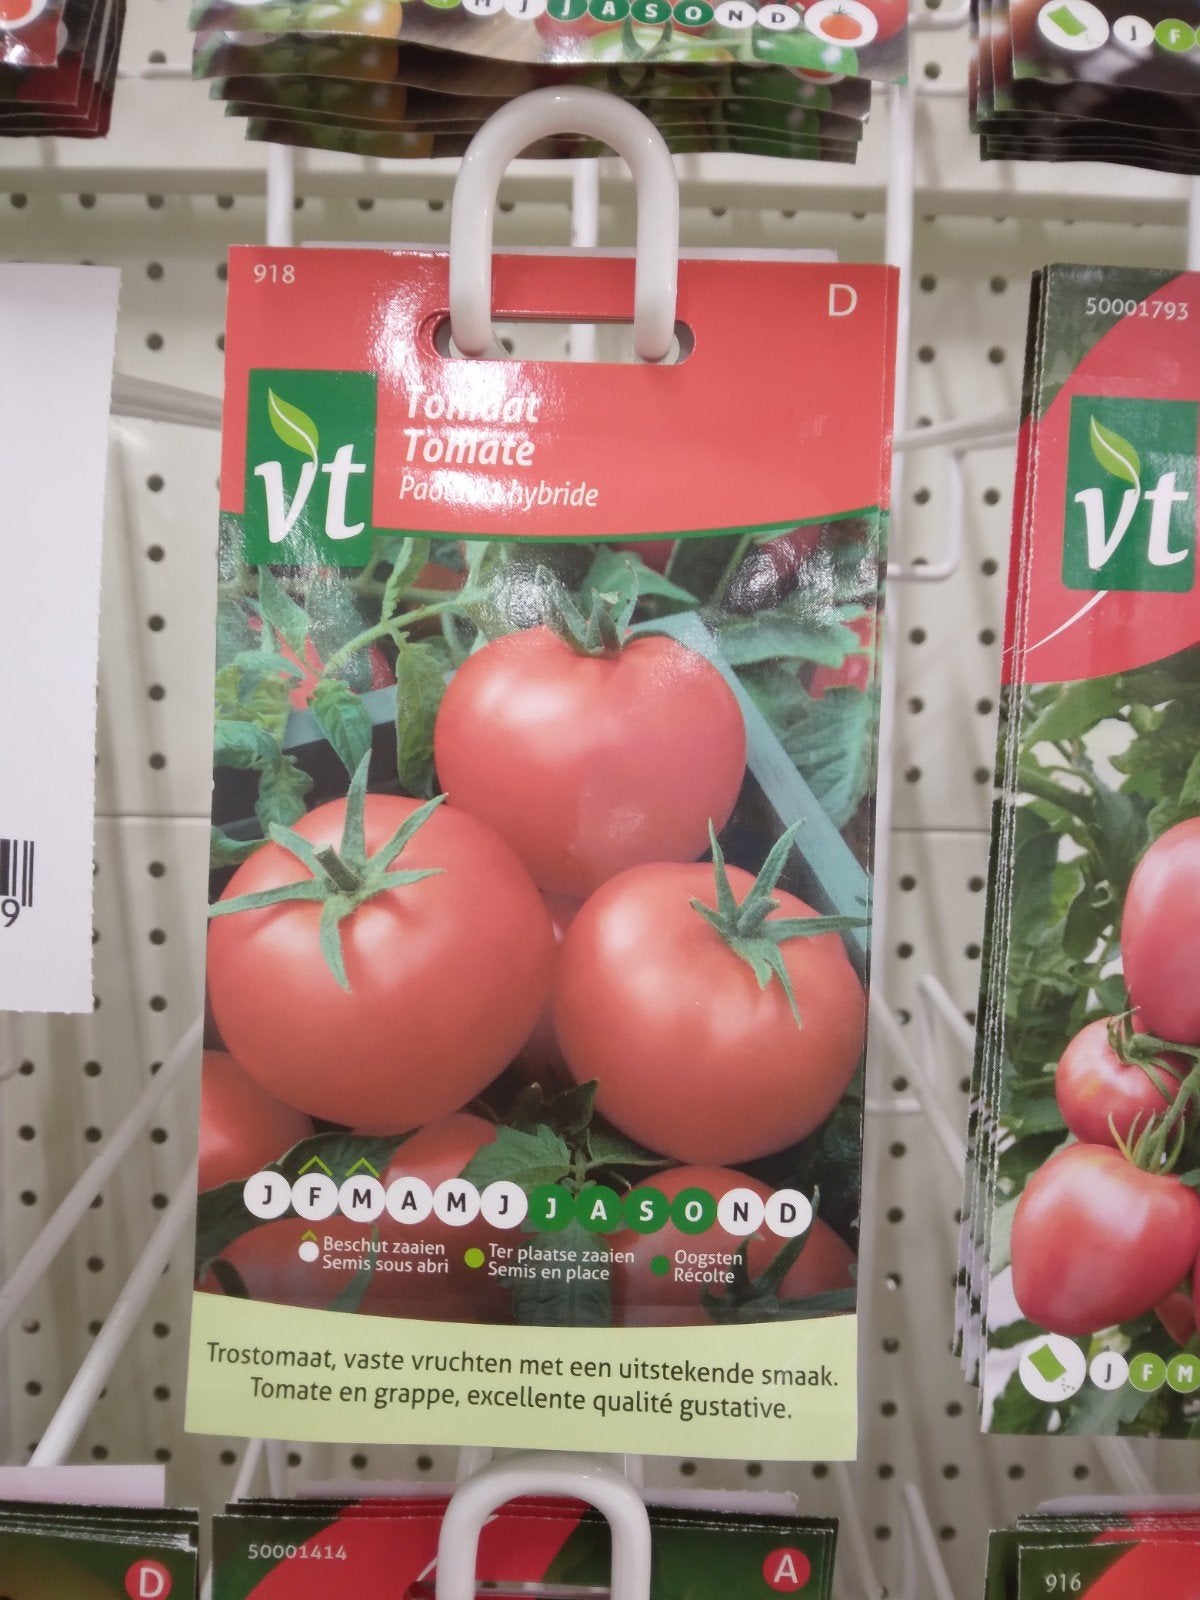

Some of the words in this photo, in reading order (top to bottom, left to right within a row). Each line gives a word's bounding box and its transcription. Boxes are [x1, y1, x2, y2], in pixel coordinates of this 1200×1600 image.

[561, 0, 571, 16] J
[602, 1, 616, 15] A
[645, 4, 658, 18] S
[685, 6, 702, 20] O
[728, 9, 743, 21] N
[771, 12, 786, 23] D
[1130, 25, 1138, 41] J
[1169, 28, 1181, 44] F
[253, 264, 296, 285] 918
[828, 283, 858, 317] D
[1085, 297, 1189, 321] 50001793
[403, 428, 536, 467] Tomate
[254, 443, 367, 544] vt
[510, 478, 599, 512] hybride
[1074, 470, 1190, 571] vt
[1, 898, 20, 928] 9
[262, 1185, 272, 1205] J
[309, 1187, 322, 1207] F
[352, 1189, 372, 1209] M
[401, 1190, 418, 1210] A
[447, 1192, 467, 1212] M
[498, 1195, 508, 1215] J
[546, 1198, 556, 1219] J
[590, 1199, 608, 1220] A
[640, 1200, 654, 1221] S
[685, 1201, 702, 1222] O
[733, 1202, 749, 1222] N
[780, 1203, 797, 1223] D
[323, 1236, 388, 1254] Beschut
[392, 1240, 445, 1256] zaaien
[488, 1243, 512, 1259] Ter
[517, 1246, 577, 1264] plaatse
[582, 1247, 635, 1264] zaaien
[323, 1255, 372, 1270] Semis
[375, 1259, 413, 1272] sous
[417, 1257, 449, 1273] abri
[674, 1249, 743, 1268] Oogsten
[488, 1264, 537, 1279] Semis
[541, 1268, 561, 1280] en
[566, 1264, 610, 1283] place
[674, 1267, 735, 1284] Récolte
[207, 1341, 337, 1371] Trostomaat,
[344, 1349, 404, 1371] vaste
[411, 1350, 512, 1374] vruchten
[519, 1356, 563, 1377] met
[570, 1359, 612, 1378] een
[619, 1358, 755, 1385] uitstekende
[761, 1365, 838, 1387] smaak.
[1103, 1363, 1112, 1383] J
[1142, 1364, 1154, 1382] F
[1177, 1364, 1194, 1383] M
[250, 1376, 332, 1402] Tomate
[339, 1384, 367, 1403] en
[373, 1386, 460, 1410] grappe,
[467, 1385, 586, 1410] excellente
[593, 1391, 673, 1418] qualité
[679, 1396, 793, 1422] gustative.
[247, 1543, 348, 1561] 50001414
[774, 1554, 799, 1584] A
[139, 1566, 165, 1599] D
[1045, 1573, 1082, 1594] 916
